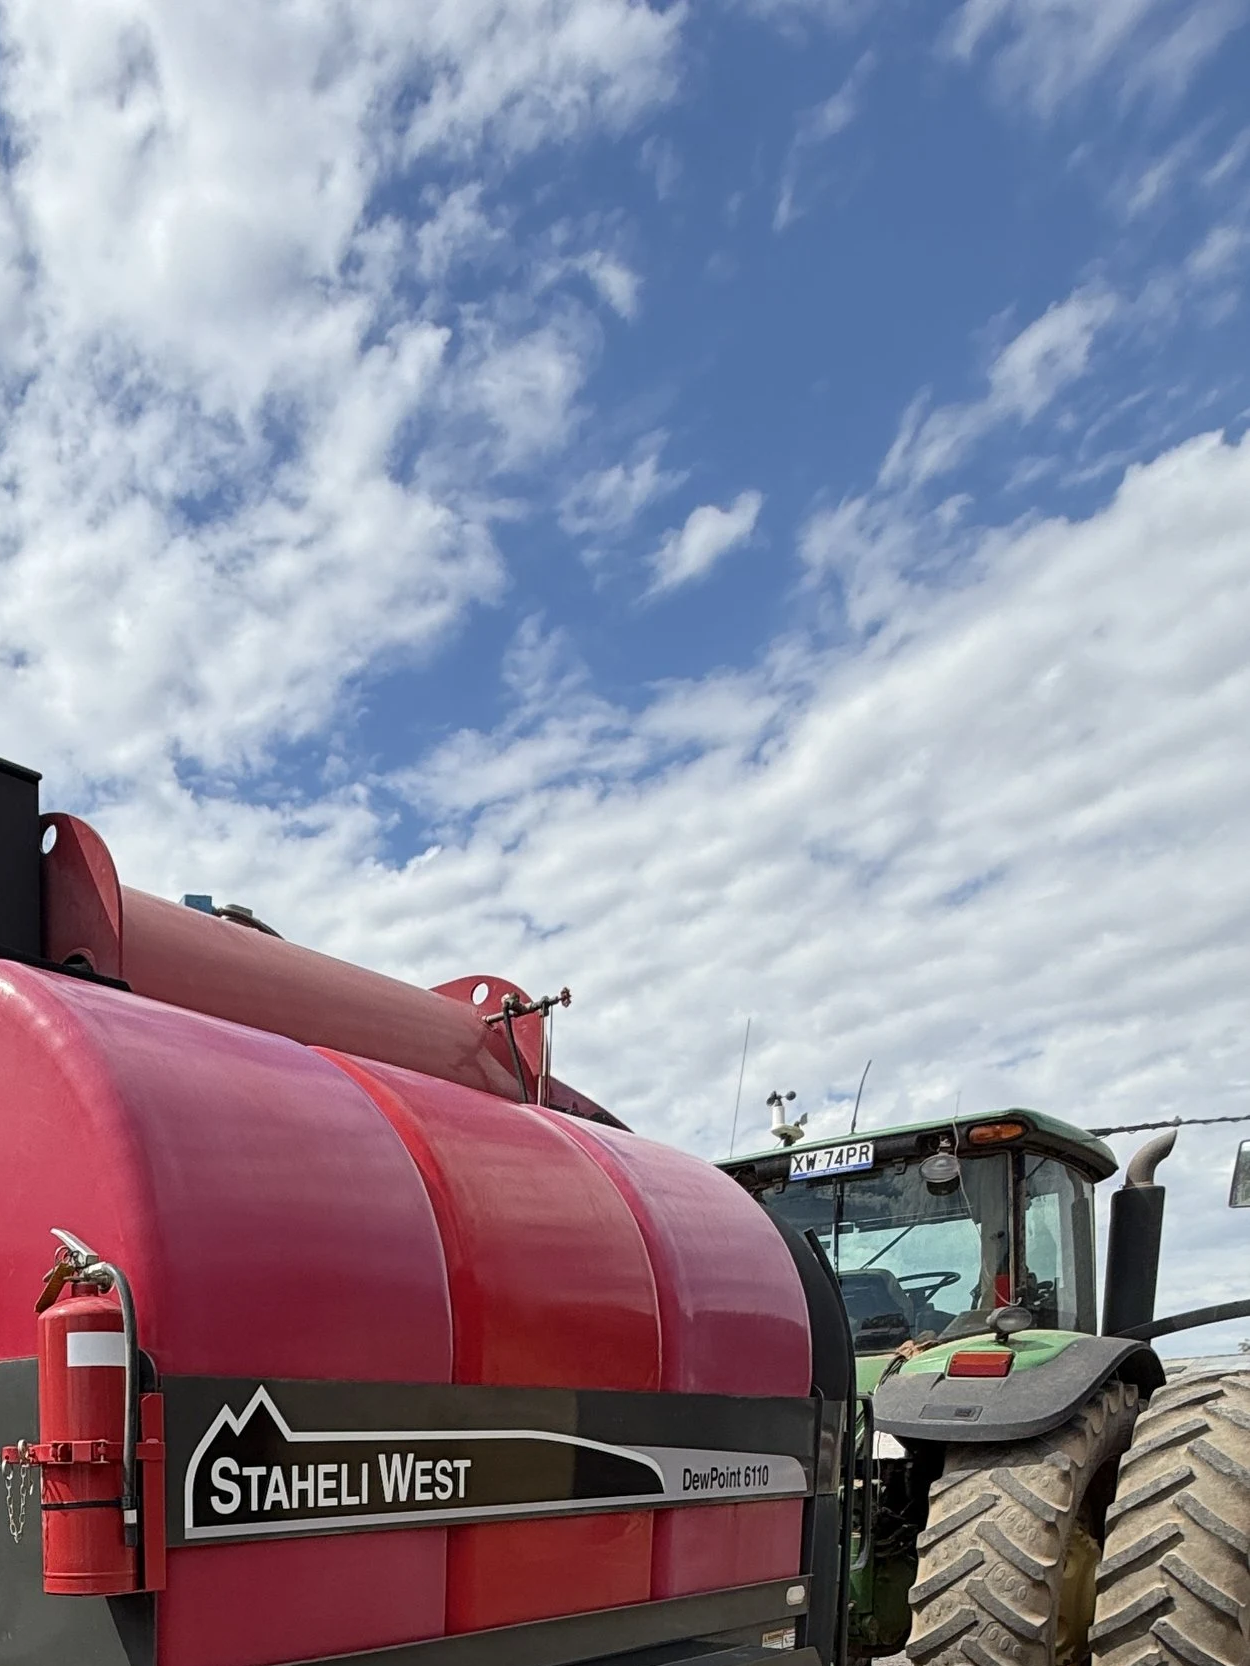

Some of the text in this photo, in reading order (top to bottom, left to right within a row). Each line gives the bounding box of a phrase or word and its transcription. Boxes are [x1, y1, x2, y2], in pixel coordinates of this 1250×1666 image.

[210, 1452, 472, 1515] STAHELI WEST
[682, 1464, 769, 1491] DewPoint 6110
